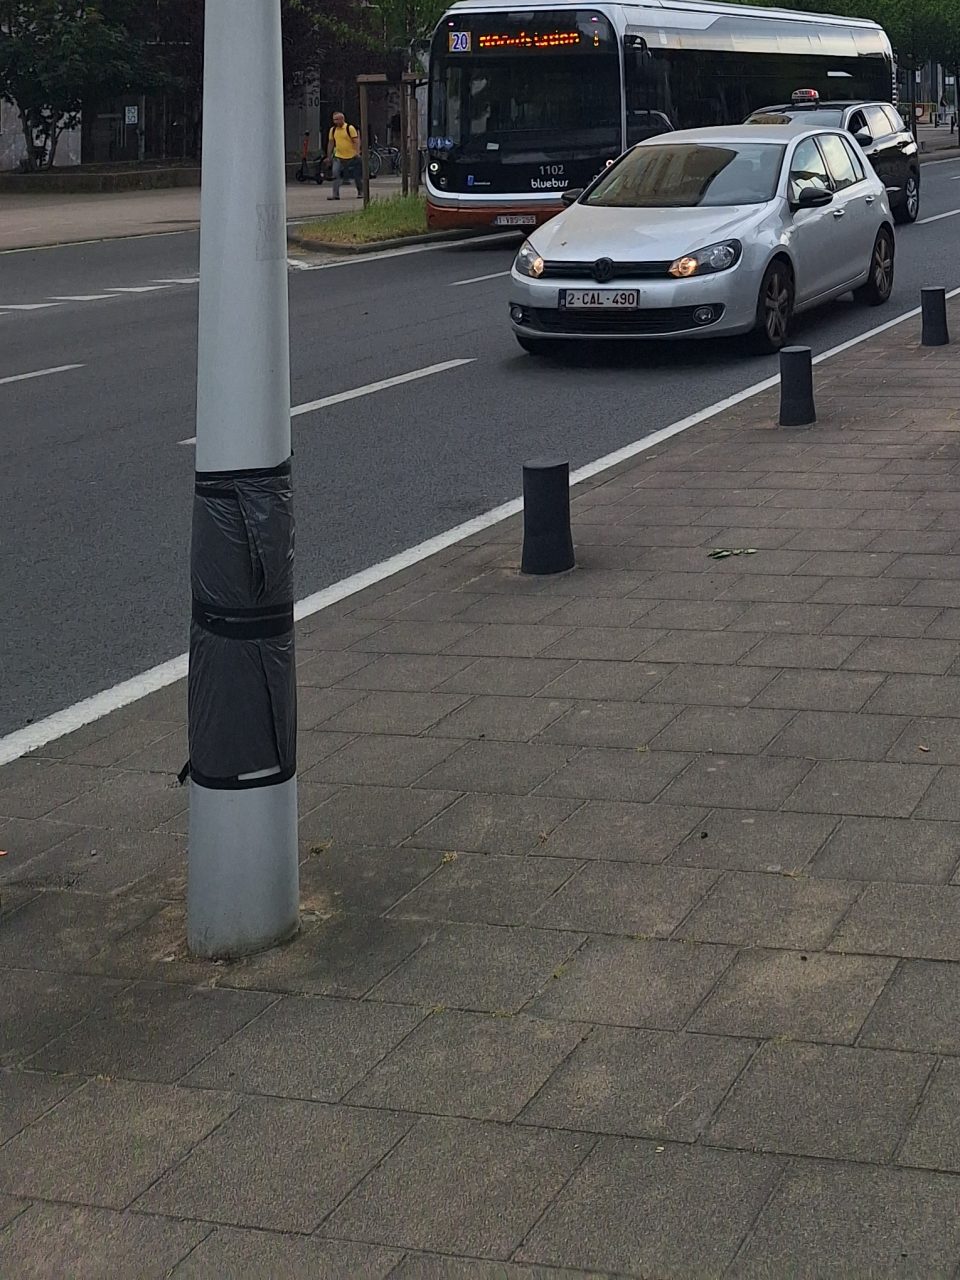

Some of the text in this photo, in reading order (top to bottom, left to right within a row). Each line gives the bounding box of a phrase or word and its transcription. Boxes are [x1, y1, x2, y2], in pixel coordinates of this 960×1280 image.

[452, 33, 468, 50] 20
[539, 164, 565, 175] 1102
[530, 177, 569, 189] bluebus
